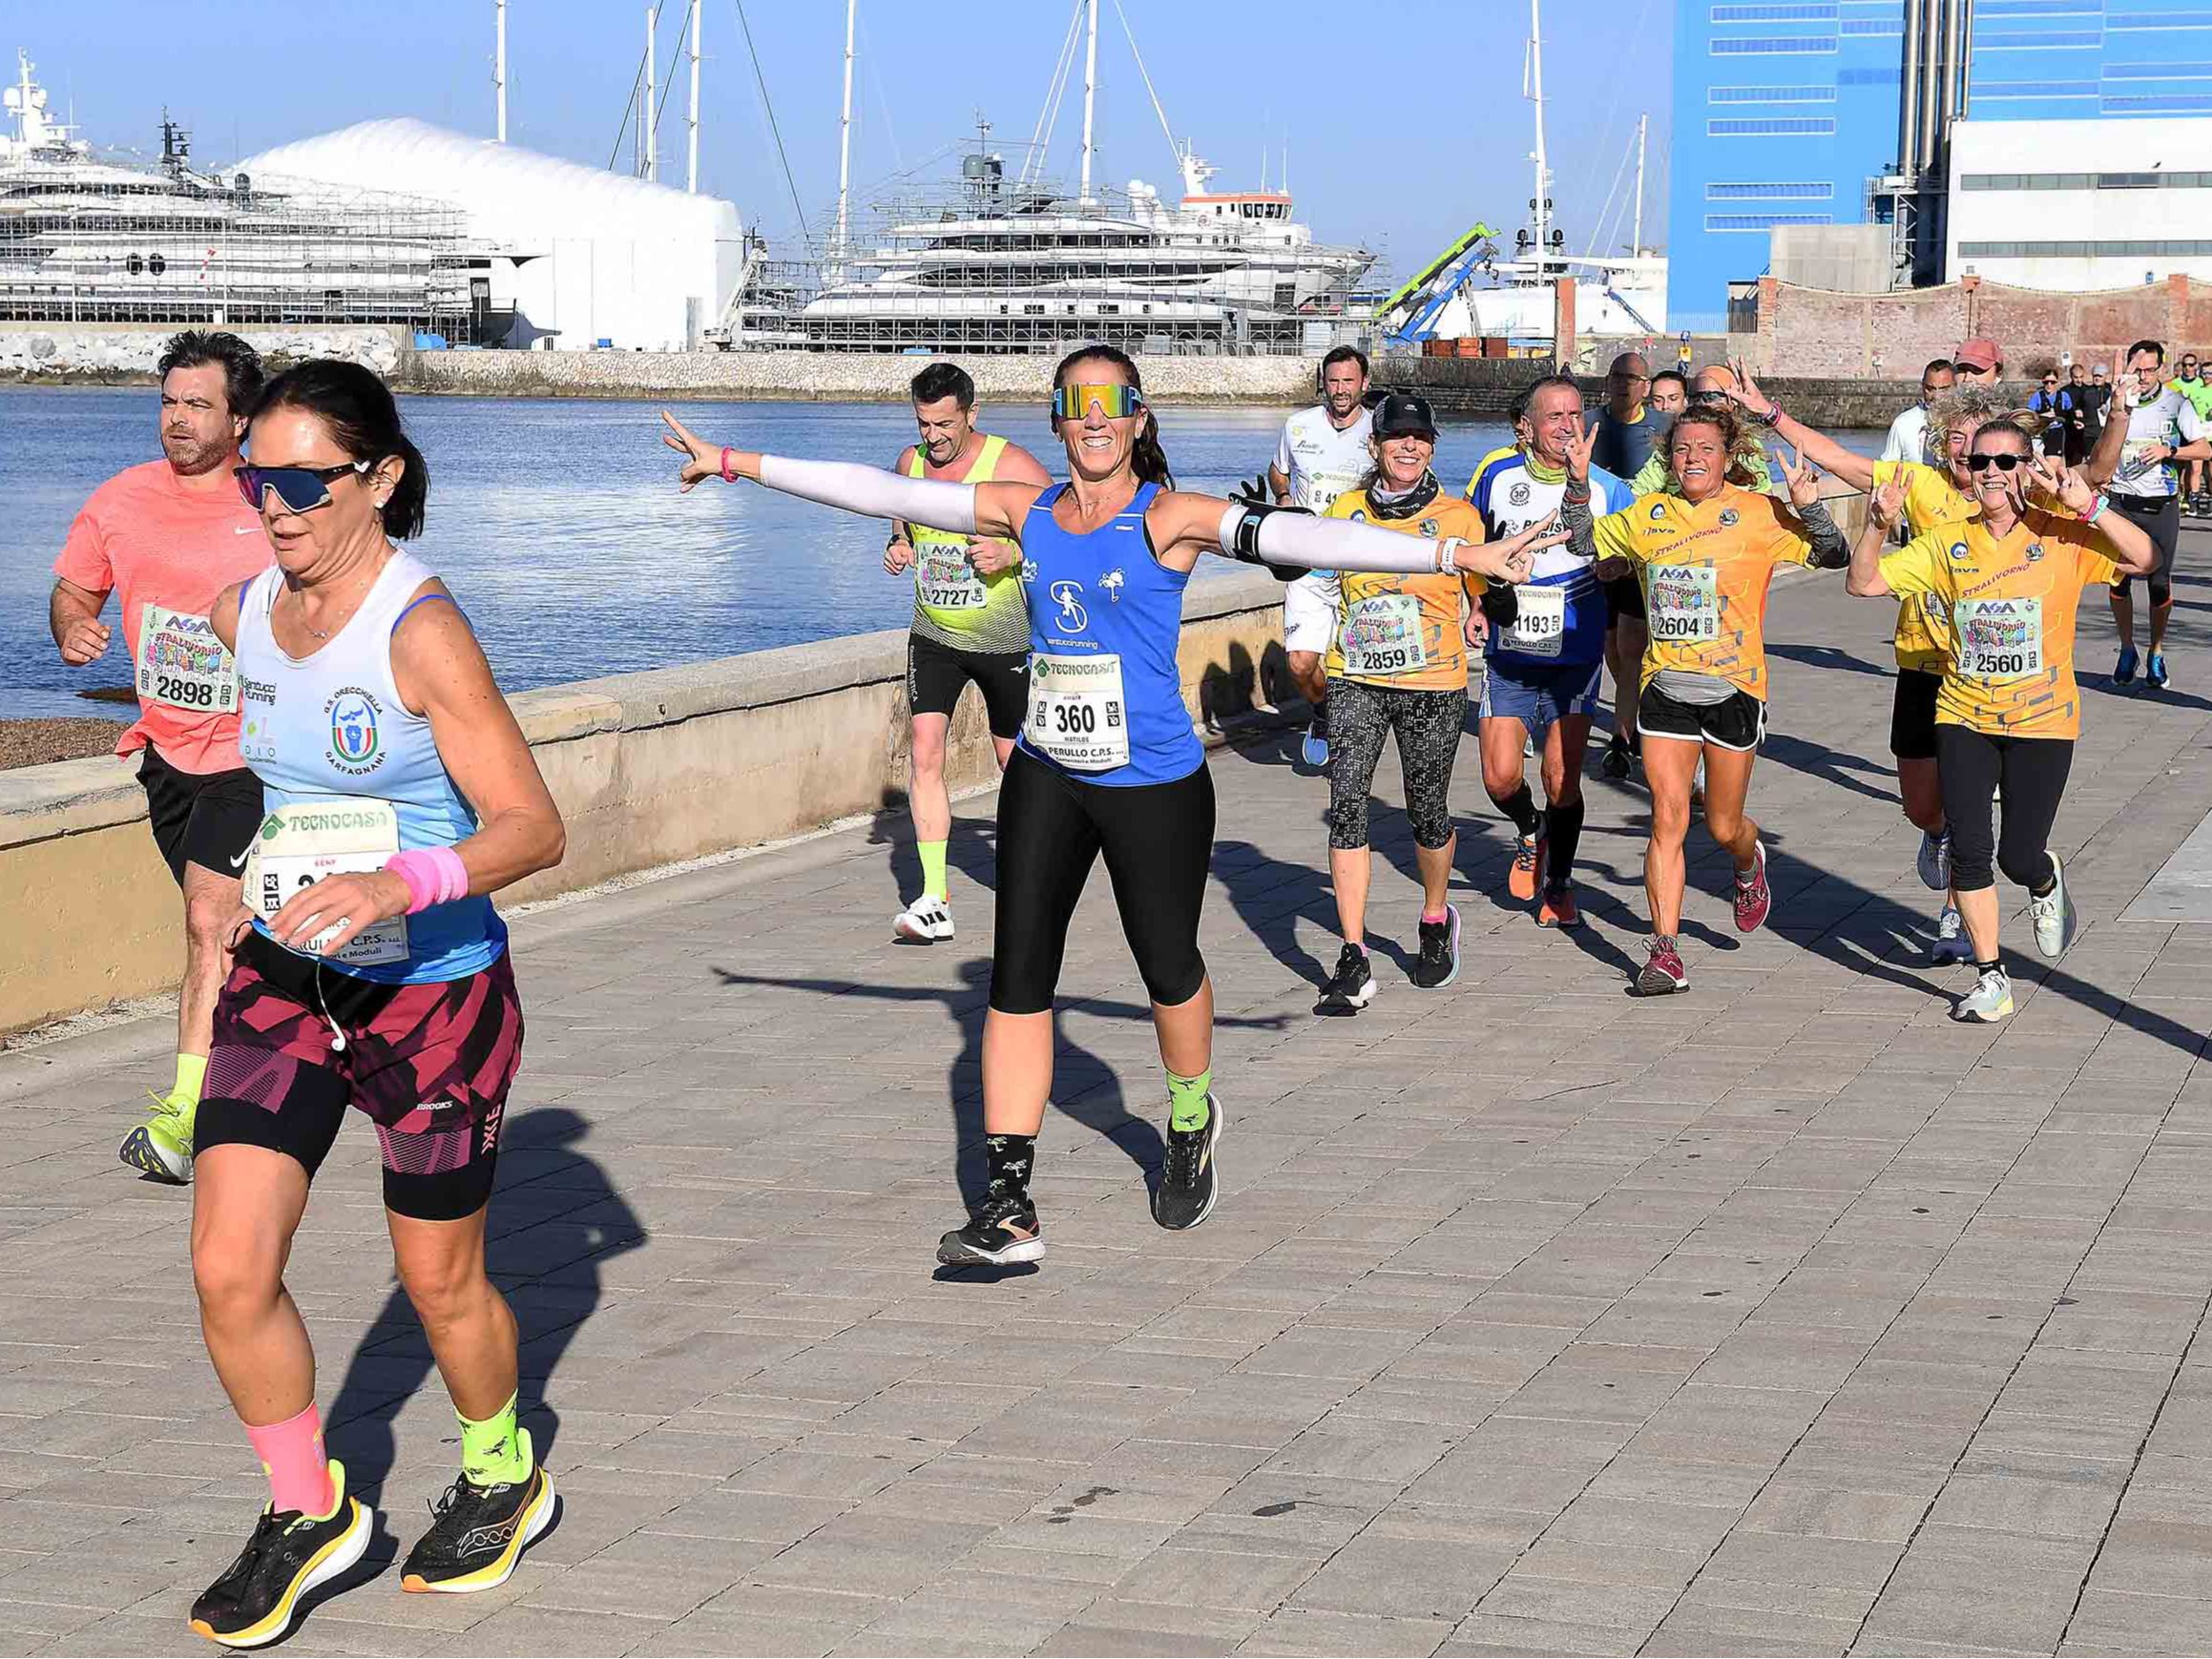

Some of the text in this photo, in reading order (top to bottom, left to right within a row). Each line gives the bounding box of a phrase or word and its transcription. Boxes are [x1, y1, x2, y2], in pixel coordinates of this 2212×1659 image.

[1654, 527, 1723, 558] STRALIVORNO
[1962, 563, 2031, 597] STRALIVORNO
[931, 589, 970, 606] 2727
[1515, 613, 1549, 633] 1193
[1658, 617, 1700, 636] 2604
[1363, 649, 1407, 670] 2859
[1976, 653, 2023, 674] 2560
[157, 675, 213, 706] 2898
[333, 686, 384, 715] ORECCHIELLA
[1054, 704, 1096, 734] 360
[1049, 746, 1089, 757] PERULLO
[1091, 747, 1116, 757] C.P.S.
[324, 750, 387, 776] GARFAGNANA
[289, 811, 387, 832] TECNOCASA
[350, 934, 386, 946] C.P.S.
[348, 947, 383, 959] Moduli
[416, 1100, 454, 1110] BROOKS
